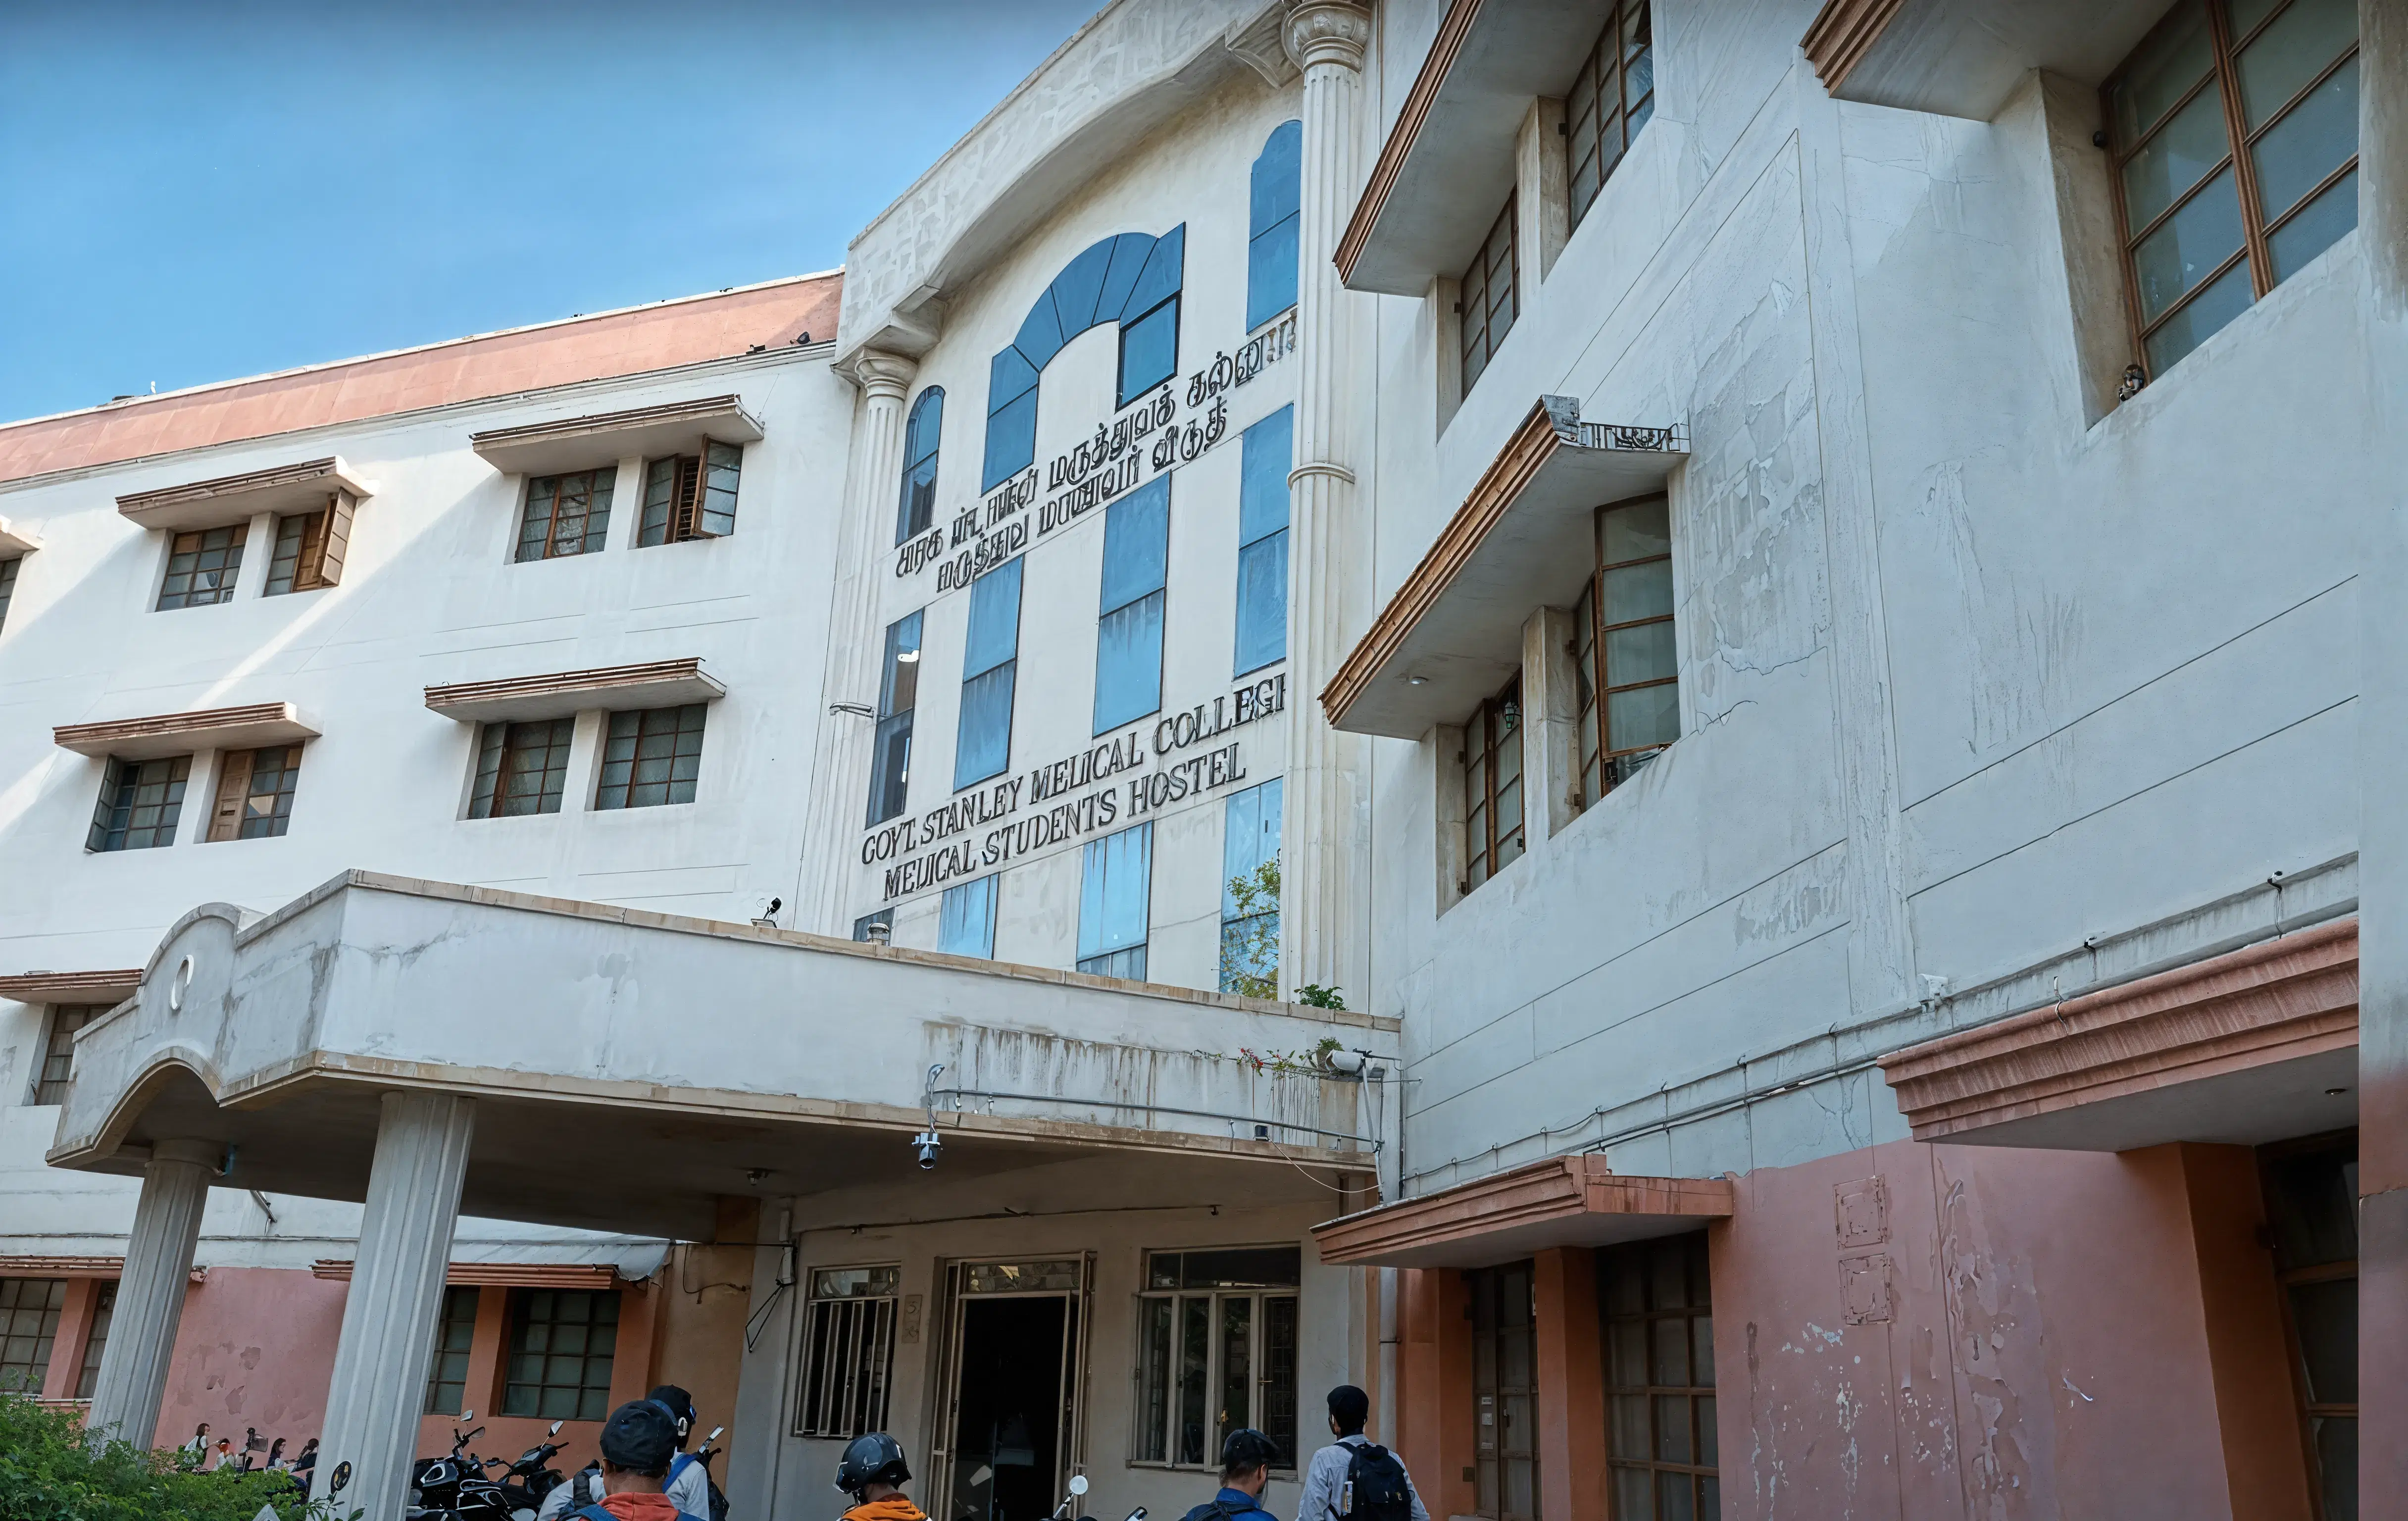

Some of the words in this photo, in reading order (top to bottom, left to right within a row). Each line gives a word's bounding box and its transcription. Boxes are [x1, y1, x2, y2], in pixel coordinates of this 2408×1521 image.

[920, 775, 1024, 845] STANLEY
[982, 787, 1117, 866] STUDENTS
[1127, 742, 1247, 818] HOSTEL
